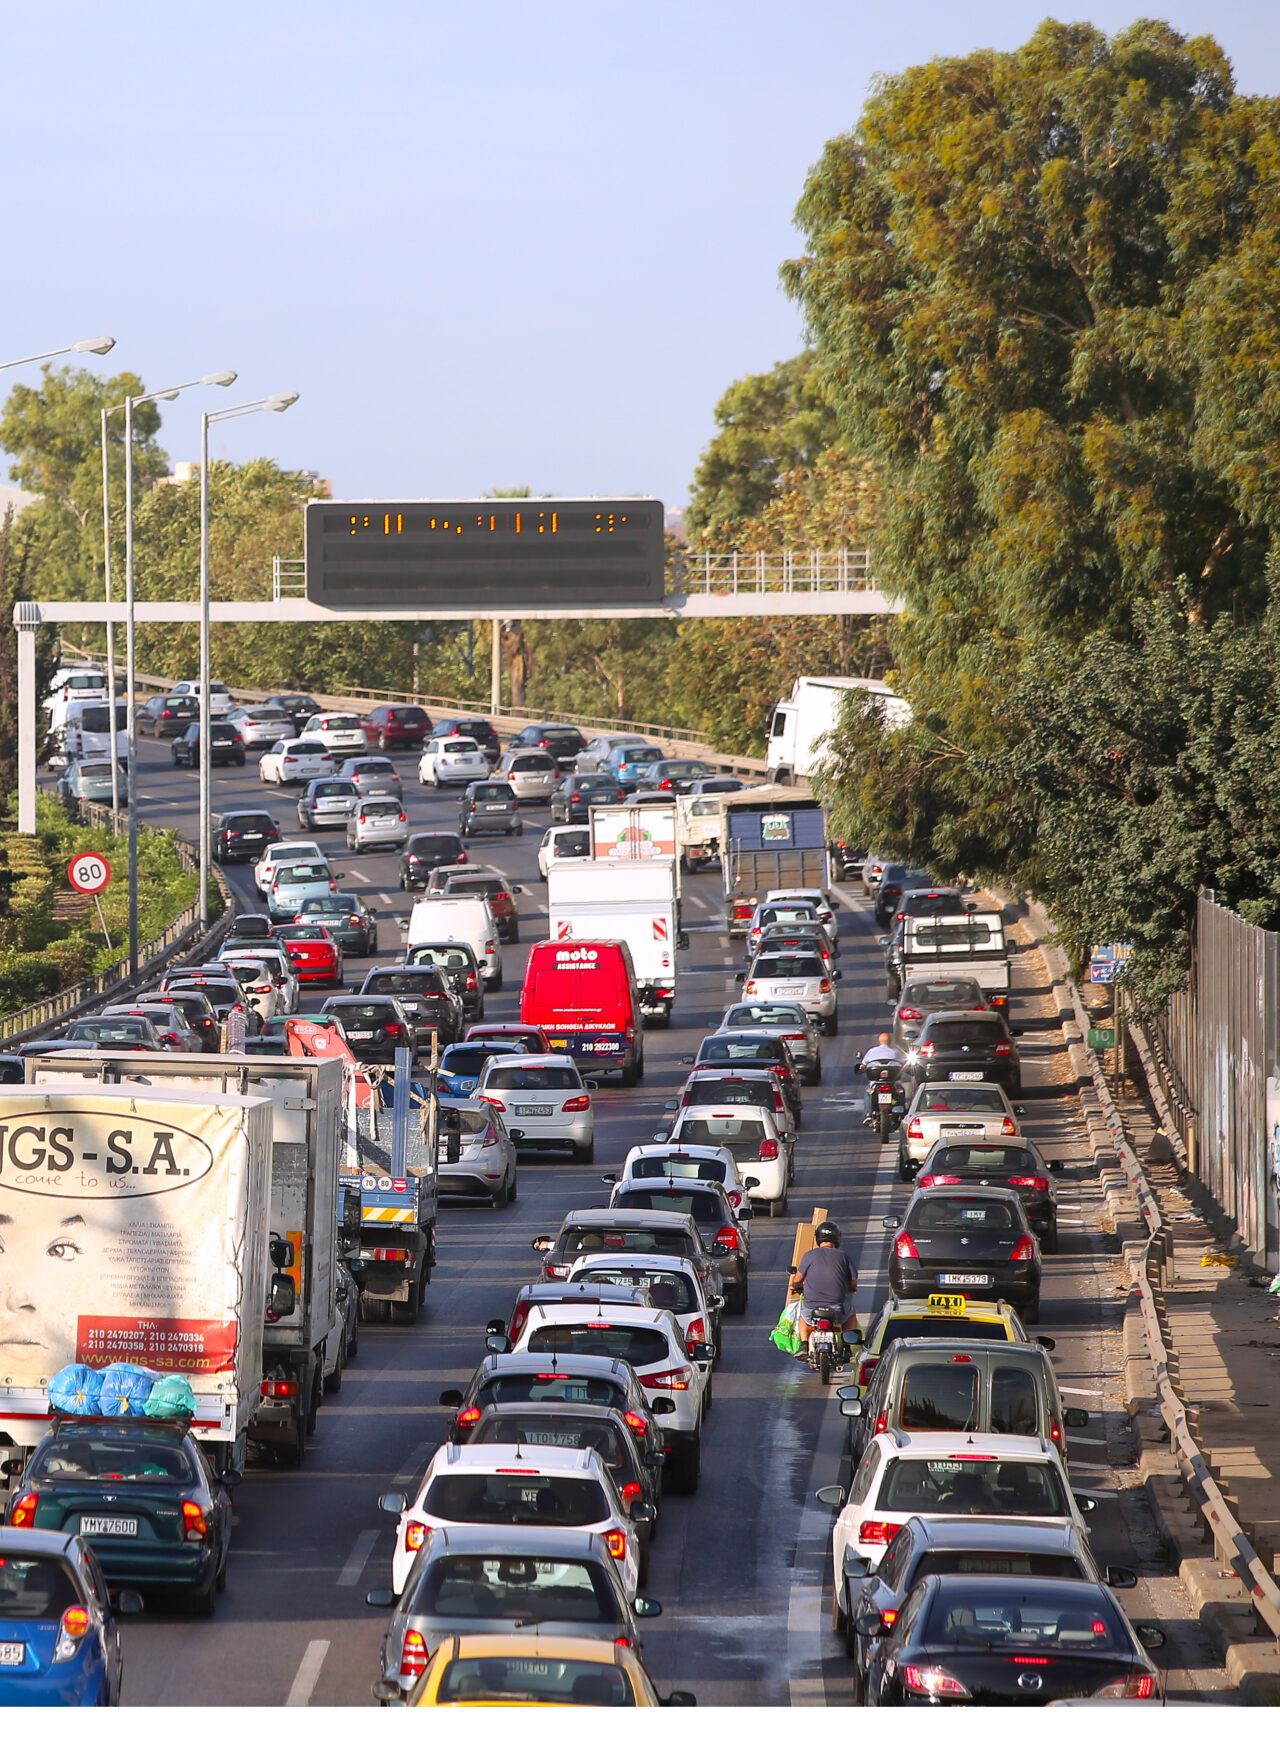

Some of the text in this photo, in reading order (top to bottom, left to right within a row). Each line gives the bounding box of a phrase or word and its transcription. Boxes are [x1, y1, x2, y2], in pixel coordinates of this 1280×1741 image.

[78, 863, 102, 883] 80
[556, 947, 598, 962] moto
[557, 962, 596, 970] ASSISTANCE
[1094, 1030, 1110, 1042] 10
[581, 1042, 593, 1052] 210
[106, 1129, 190, 1177] S.A.
[15, 1170, 136, 1190] come to us...
[365, 1179, 374, 1187] 70
[932, 1297, 961, 1307] TAXI
[88, 1329, 205, 1342] 210 2470207, 210 2470334
[88, 1340, 204, 1353] 210 2470358, 210 2470319
[81, 1352, 211, 1368] wwwjgs-sa.com
[108, 1520, 136, 1533] 7600
